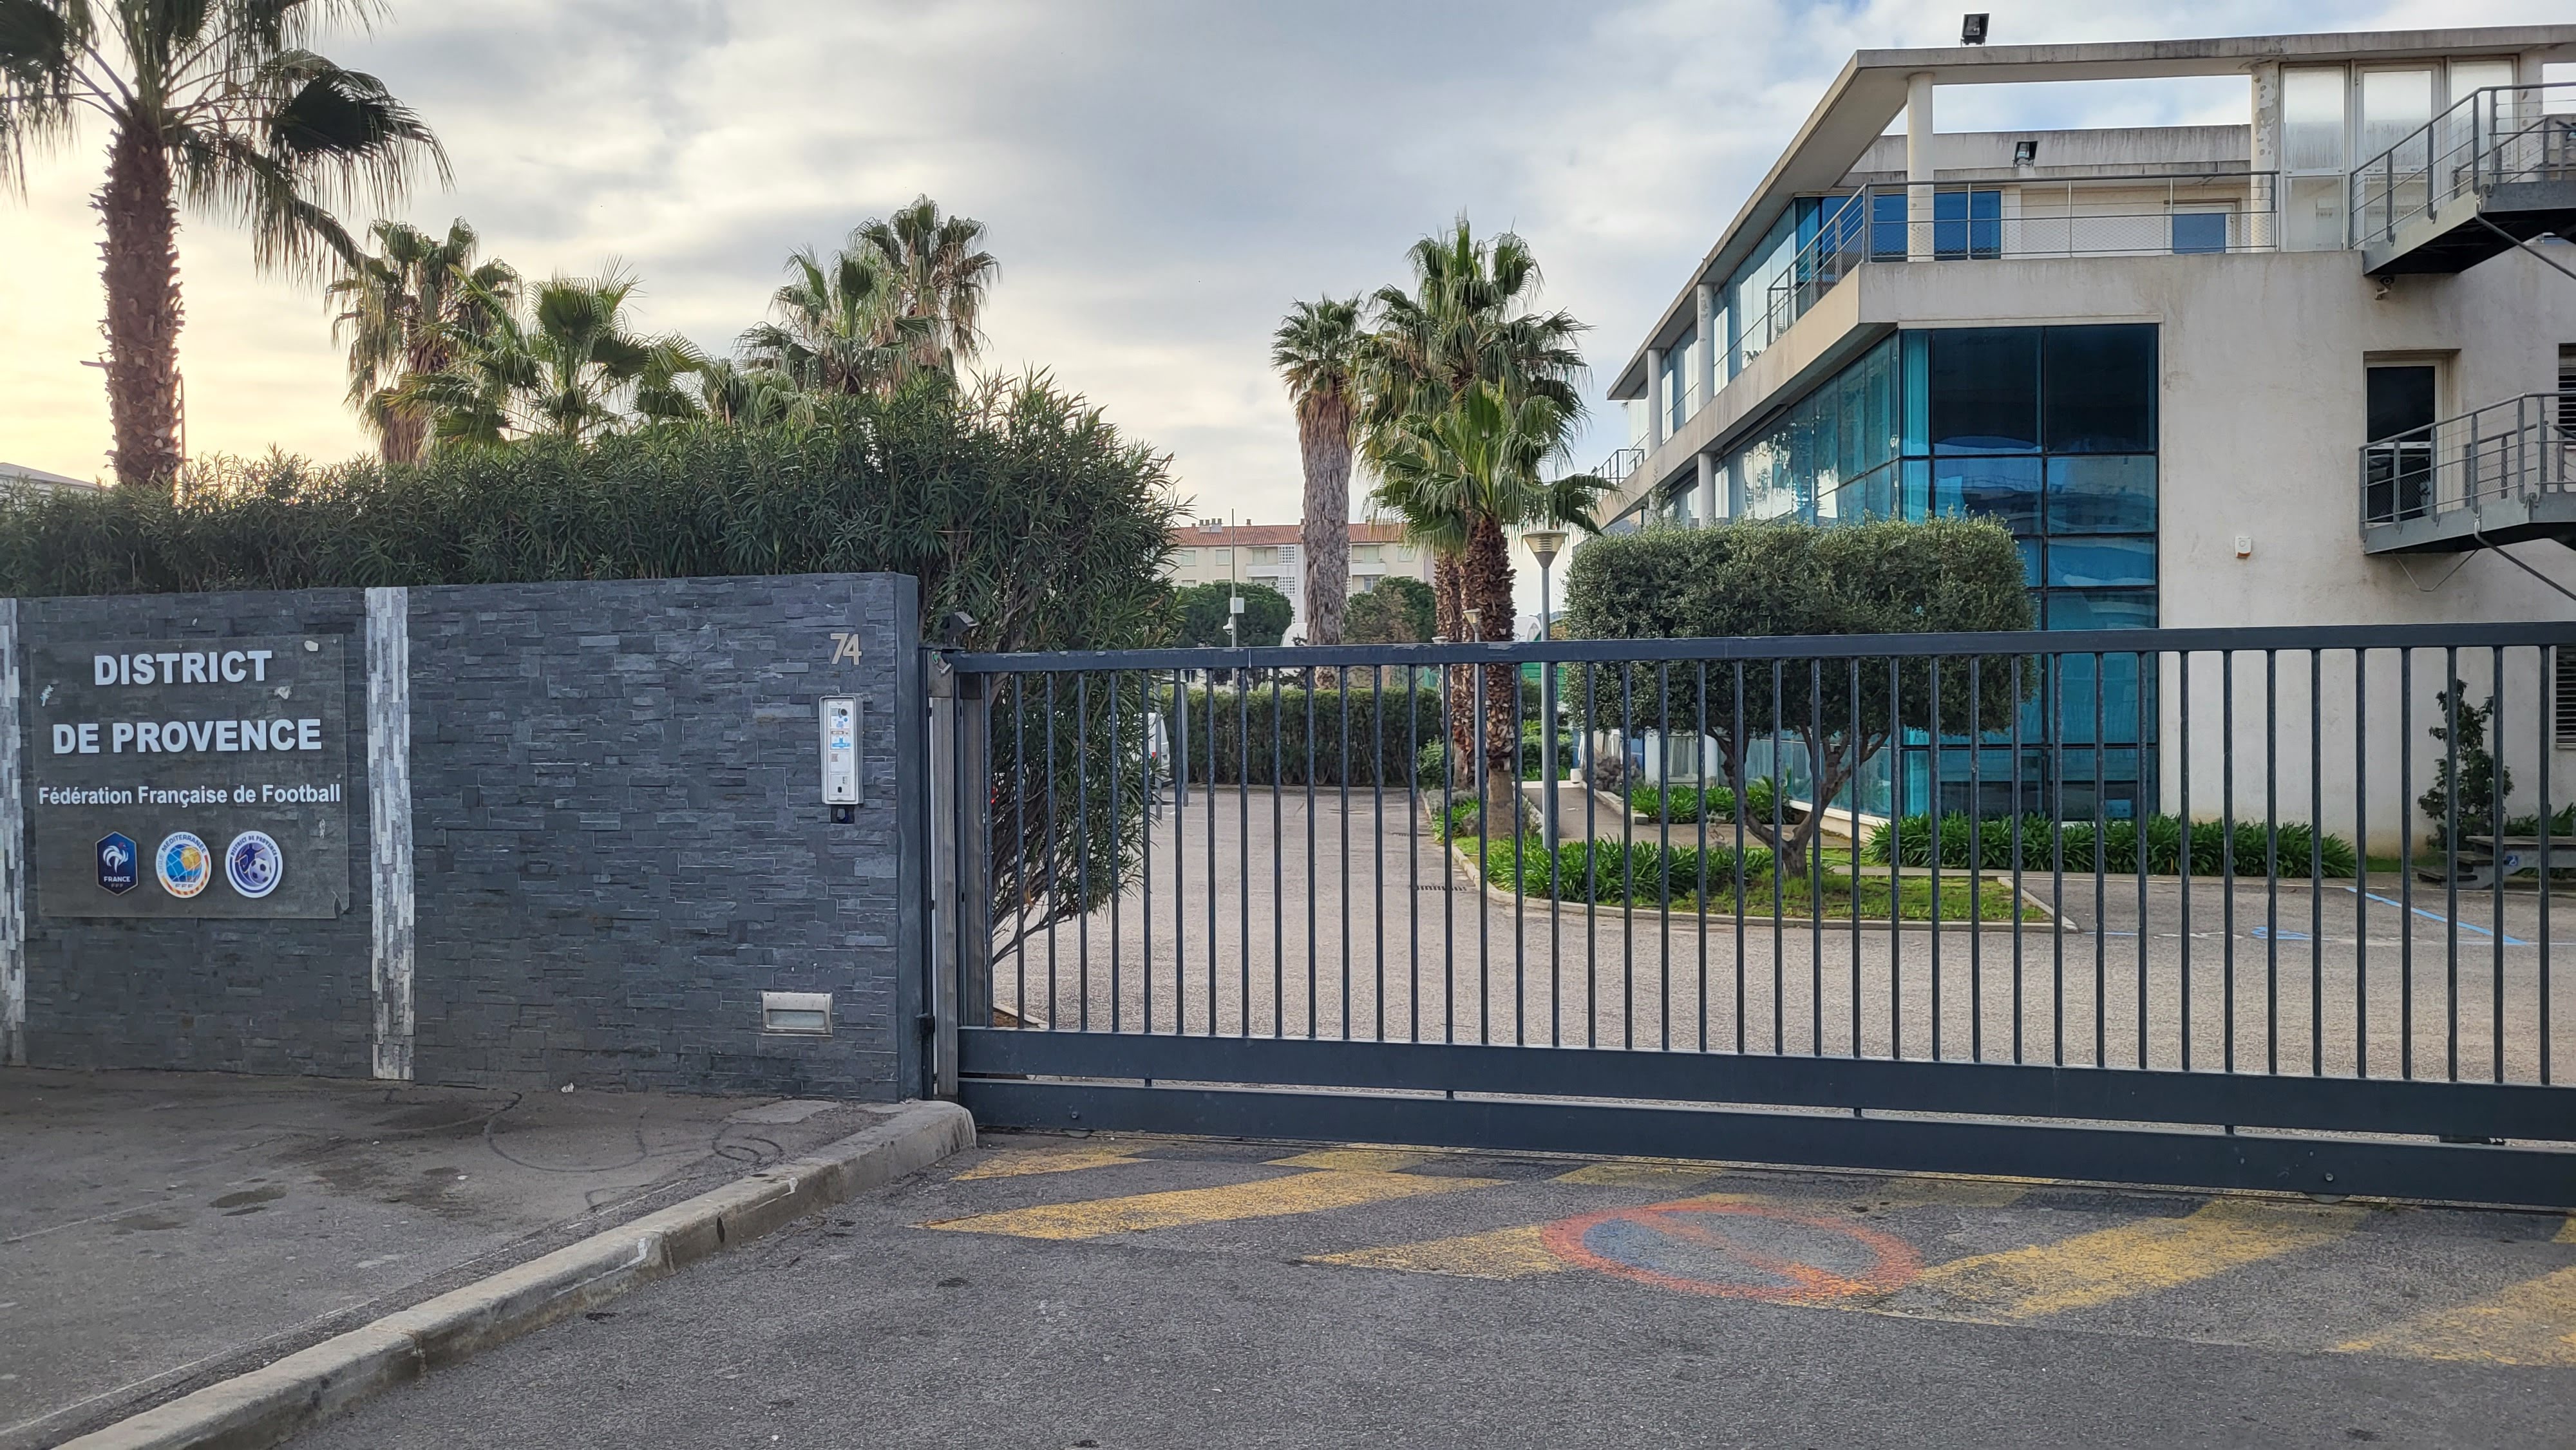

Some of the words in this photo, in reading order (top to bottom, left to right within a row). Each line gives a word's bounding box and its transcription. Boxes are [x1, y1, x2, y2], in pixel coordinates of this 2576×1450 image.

[830, 633, 862, 665] 74
[95, 650, 272, 686] DISTRICT
[53, 723, 100, 754] DE
[113, 719, 322, 753] PROVENCE
[39, 786, 132, 804] Fédération
[138, 786, 227, 808] Française
[233, 785, 256, 803] de
[262, 784, 340, 803] Football
[231, 837, 247, 856] DISTRICT
